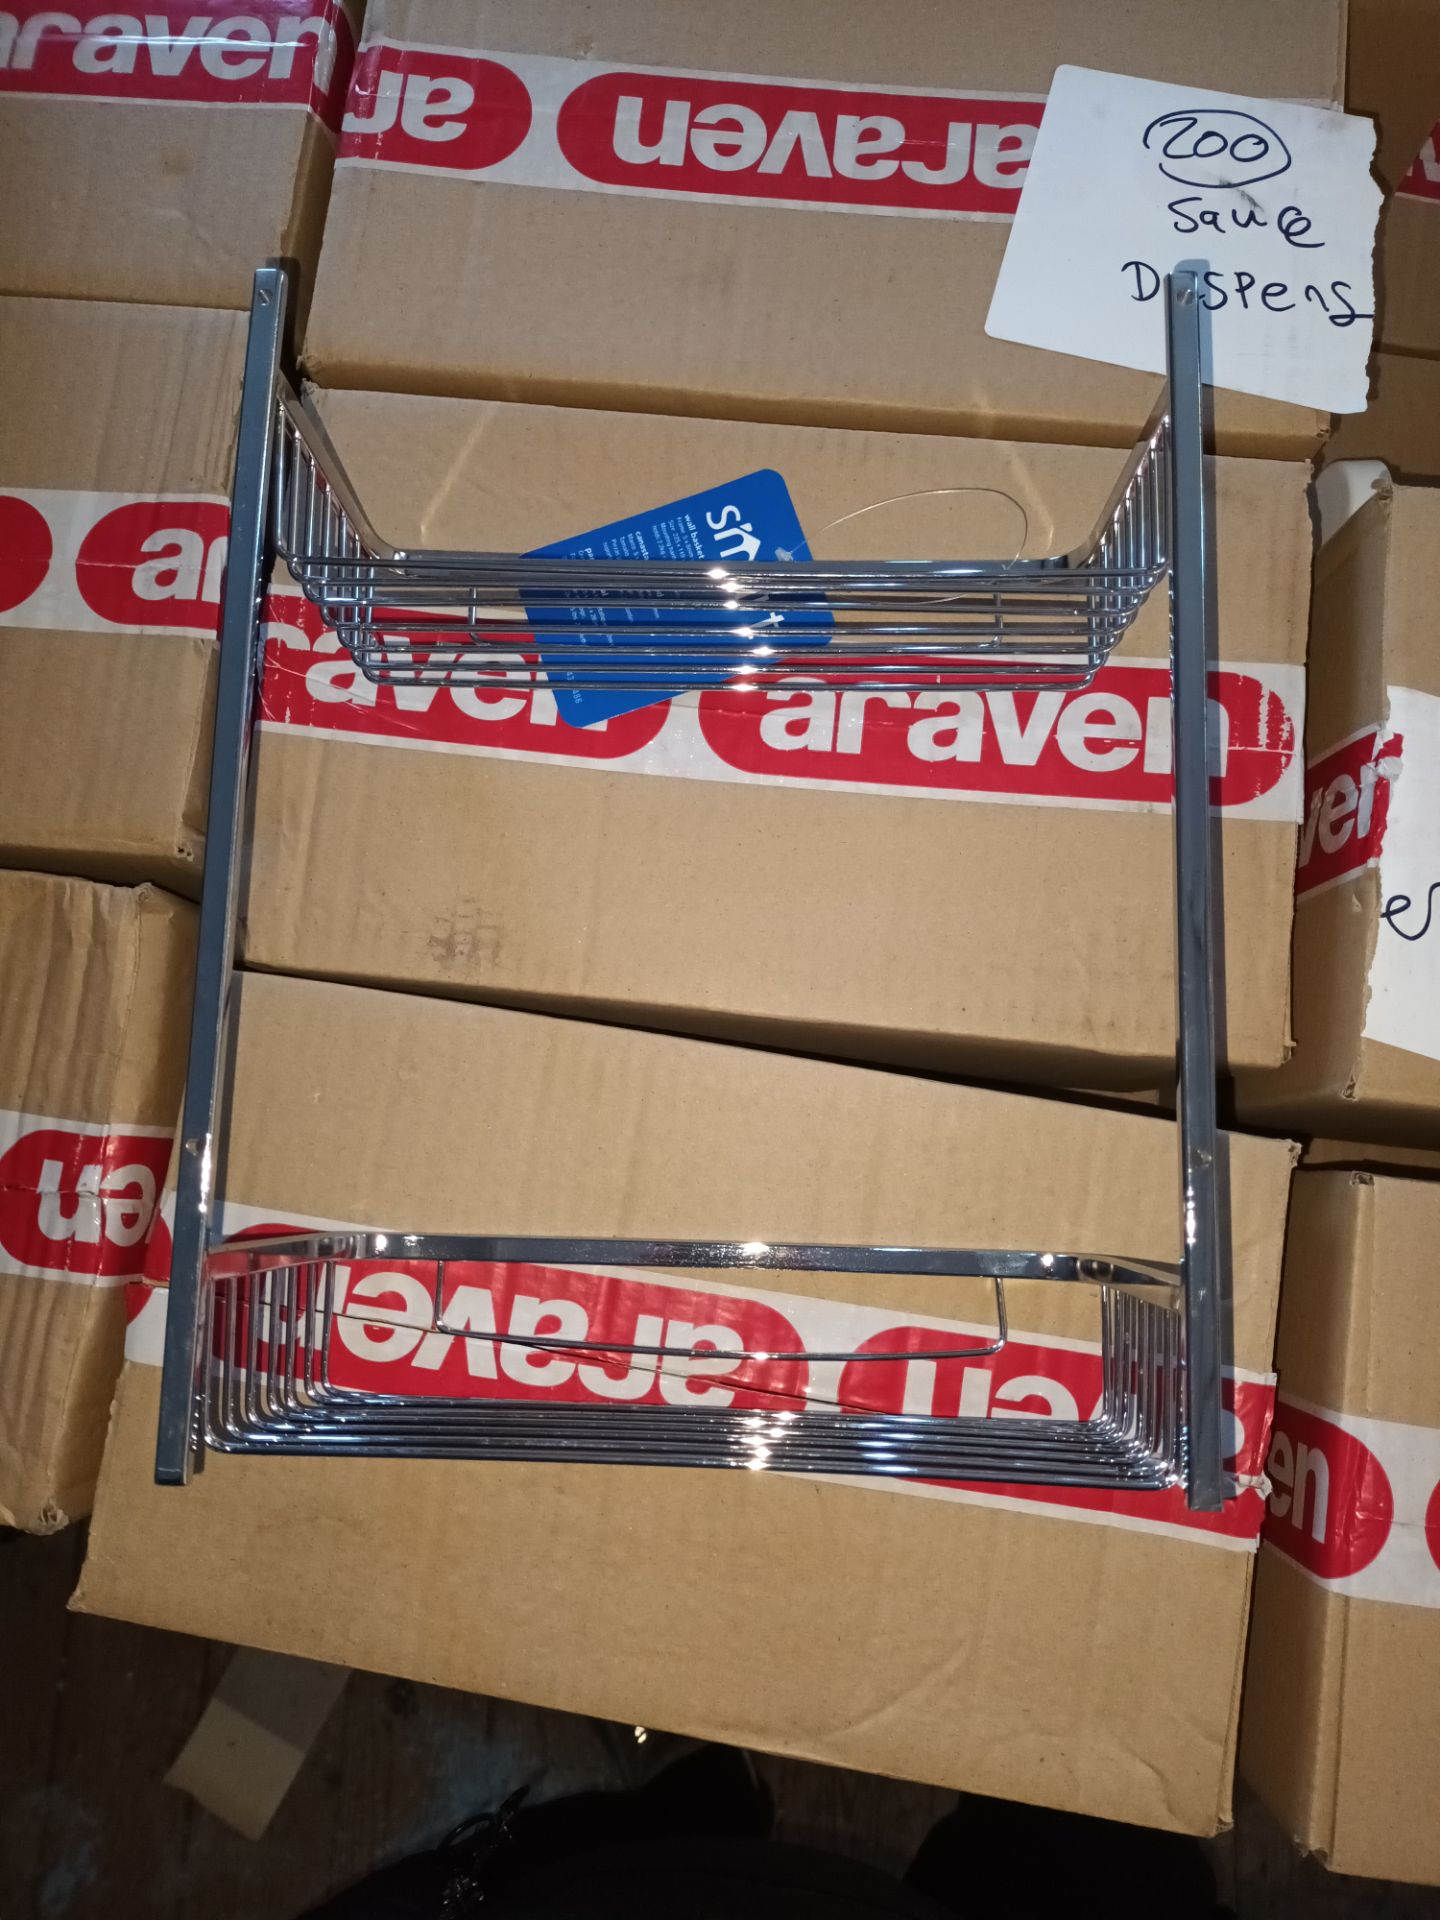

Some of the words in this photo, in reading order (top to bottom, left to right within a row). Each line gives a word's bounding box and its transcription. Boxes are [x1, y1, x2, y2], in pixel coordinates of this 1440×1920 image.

[0, 11, 337, 95] raven
[1159, 117, 1269, 162] 200
[1167, 197, 1326, 248] Sauce
[1121, 261, 1374, 327] Dspens
[685, 514, 696, 531] wall
[690, 532, 705, 559] basket
